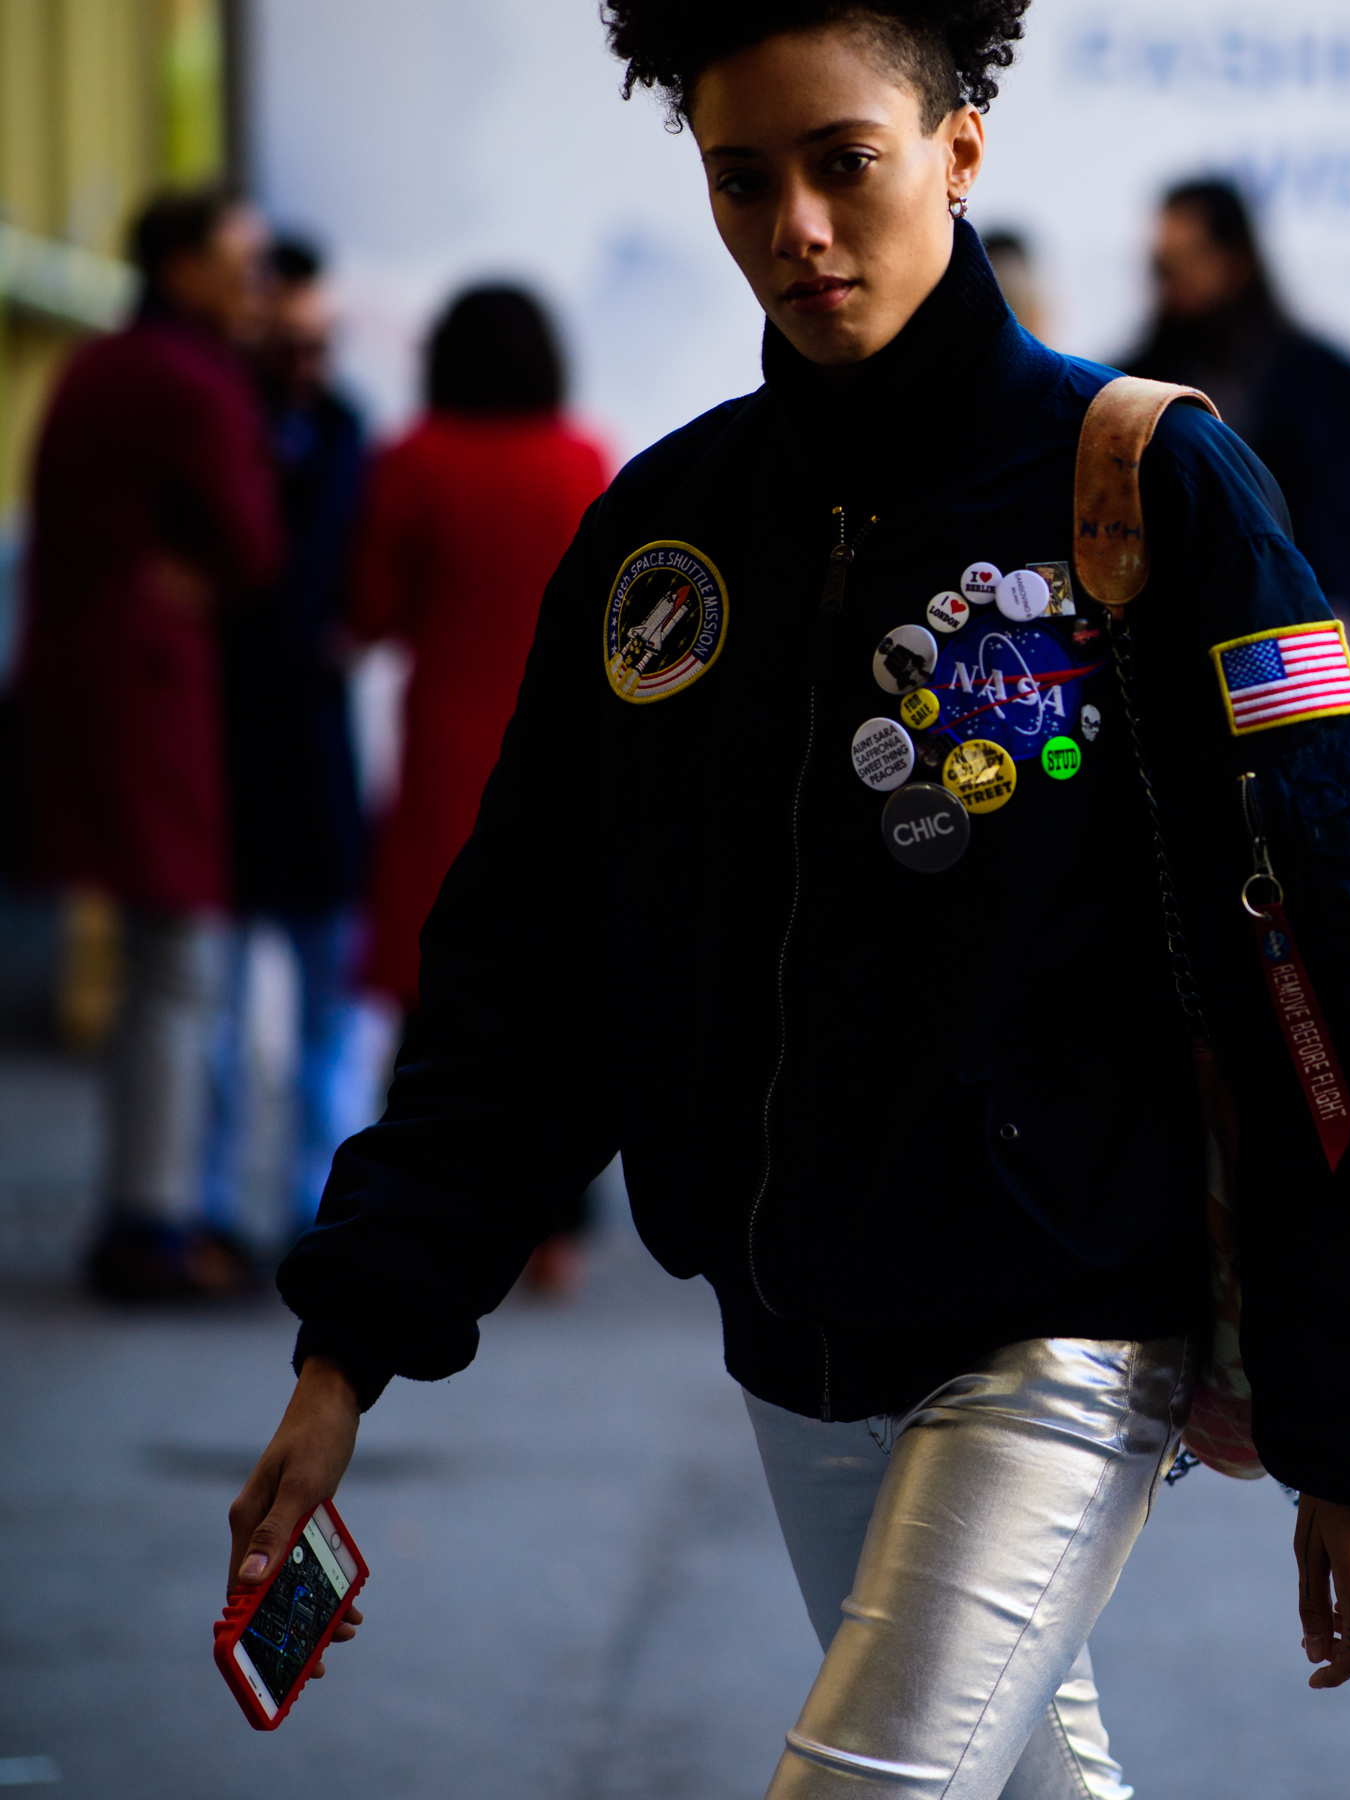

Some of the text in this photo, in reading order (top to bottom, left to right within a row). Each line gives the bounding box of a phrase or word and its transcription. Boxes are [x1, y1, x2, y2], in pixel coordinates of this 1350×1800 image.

[965, 583, 996, 594] BERLIN
[970, 571, 979, 583] I
[612, 552, 718, 656] 100th SPACE SHUTTLE MISSION
[941, 595, 950, 606] I
[1014, 572, 1031, 613] SANSOVINO
[929, 605, 960, 629] LONDON
[948, 661, 1066, 717] NASA
[904, 693, 922, 714] FOR
[910, 703, 933, 726] SALE
[852, 725, 898, 756] AUNT SARA
[856, 736, 902, 766] SAFFRONIA
[858, 744, 909, 779] SWEET THING
[869, 758, 907, 785] PEACHES
[1047, 748, 1078, 771] STUD
[893, 811, 955, 846] CHIC
[1272, 963, 1347, 1121] REMOVE BEFORE FLIGHT
